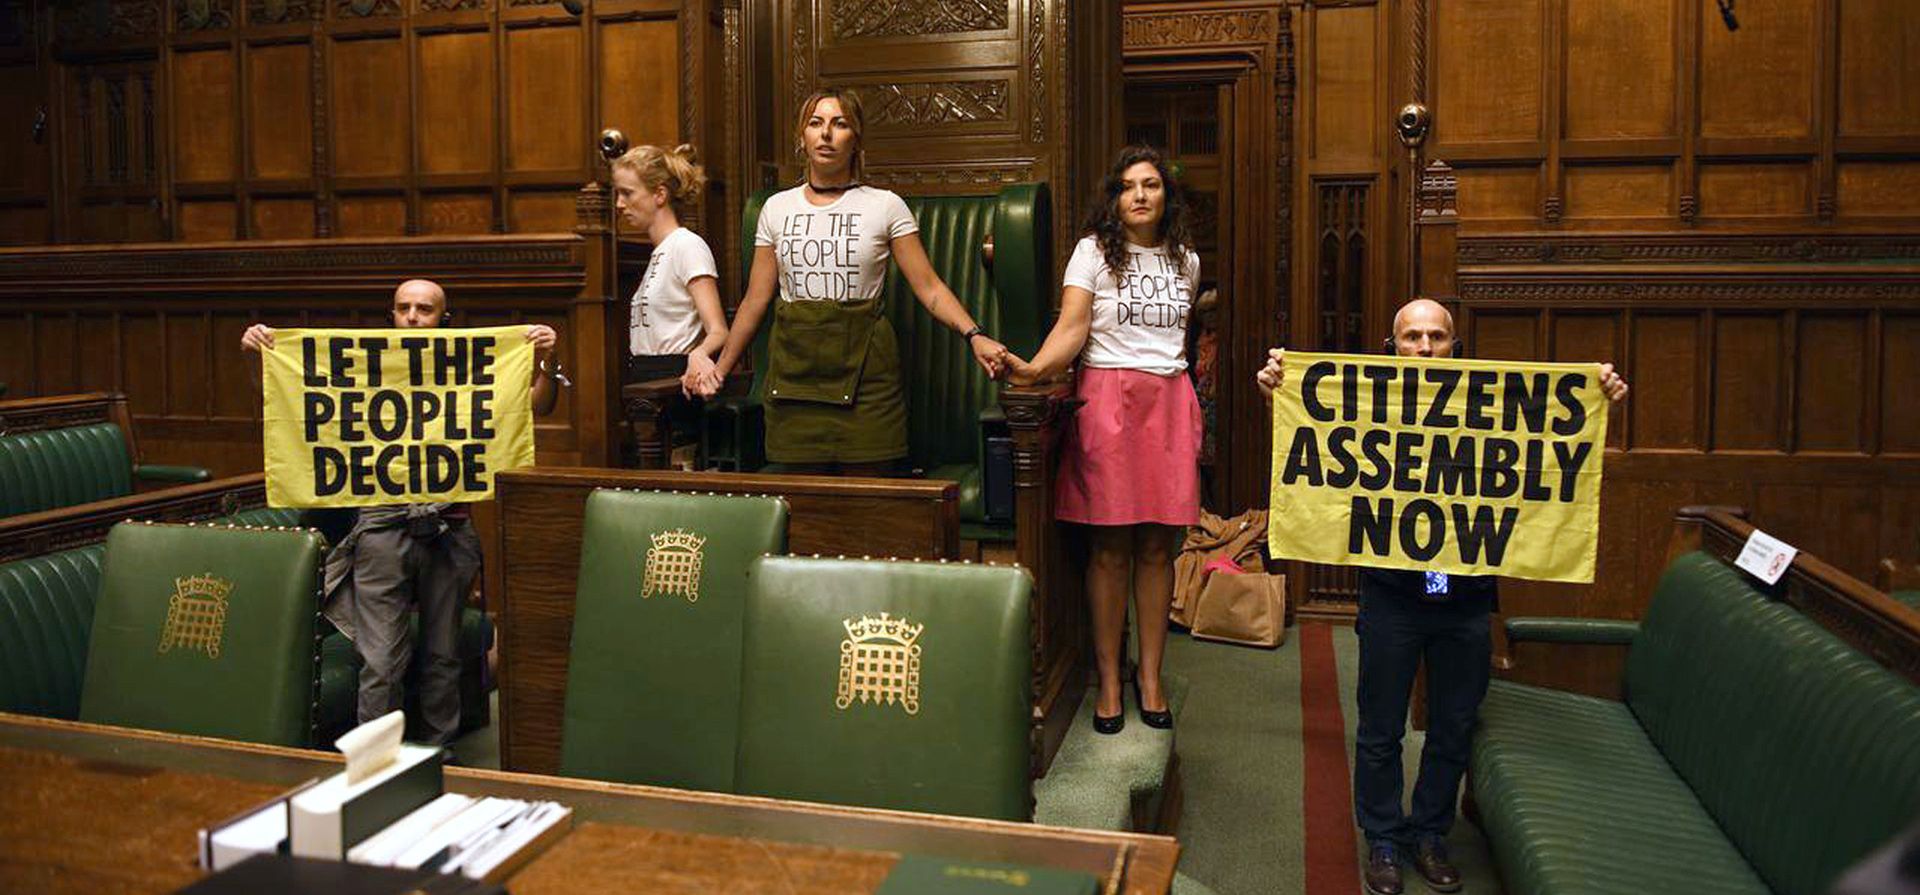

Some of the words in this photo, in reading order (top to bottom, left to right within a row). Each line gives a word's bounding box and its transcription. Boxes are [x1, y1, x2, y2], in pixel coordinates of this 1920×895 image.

[783, 213, 815, 236] LET
[828, 213, 861, 237] THE
[781, 238, 859, 268] PEOPLE
[783, 271, 860, 300] DECIDE
[1117, 274, 1187, 302] PEOPLE
[1117, 301, 1187, 329] DECIDE
[302, 336, 388, 387] LET
[401, 336, 496, 386] THE
[304, 389, 496, 442] PEOPLE
[1301, 361, 1588, 436] CITIZENS
[313, 444, 488, 497] DECIDE
[1281, 426, 1593, 503] ASSEMBLY
[1348, 496, 1520, 567] NOW
